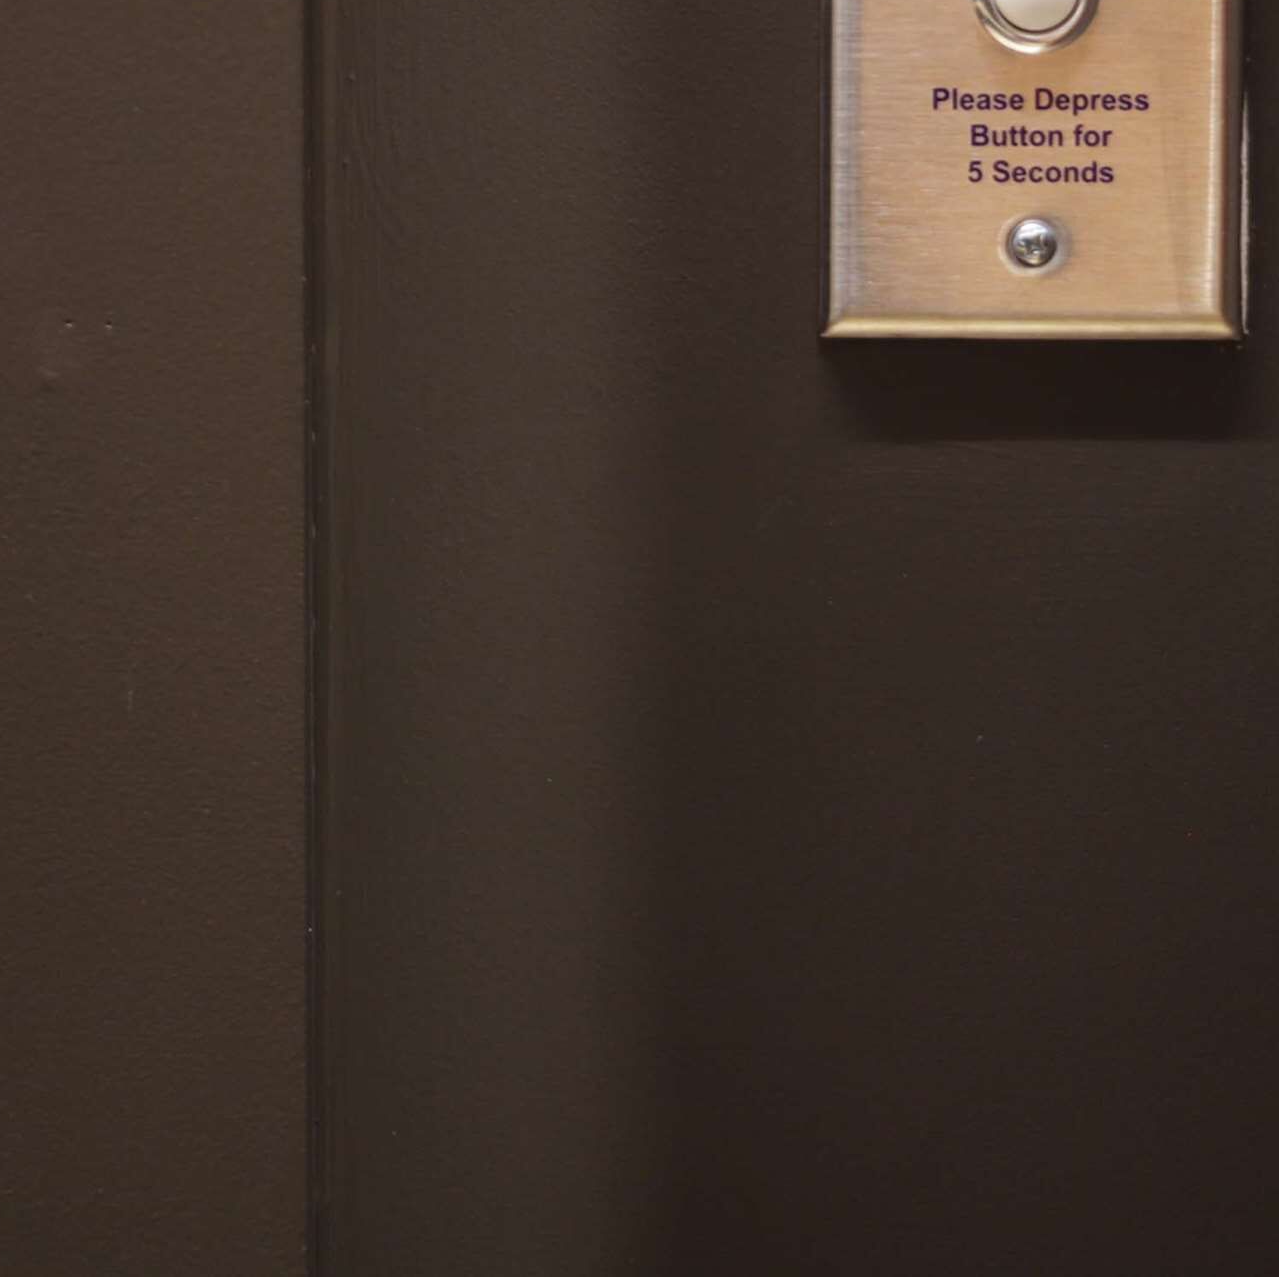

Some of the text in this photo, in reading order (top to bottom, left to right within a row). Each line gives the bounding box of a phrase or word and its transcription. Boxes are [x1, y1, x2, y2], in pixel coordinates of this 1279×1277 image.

[932, 87, 1150, 117] Please Depress
[970, 123, 1113, 148] Button for
[968, 159, 1115, 184] 5 Seconds
